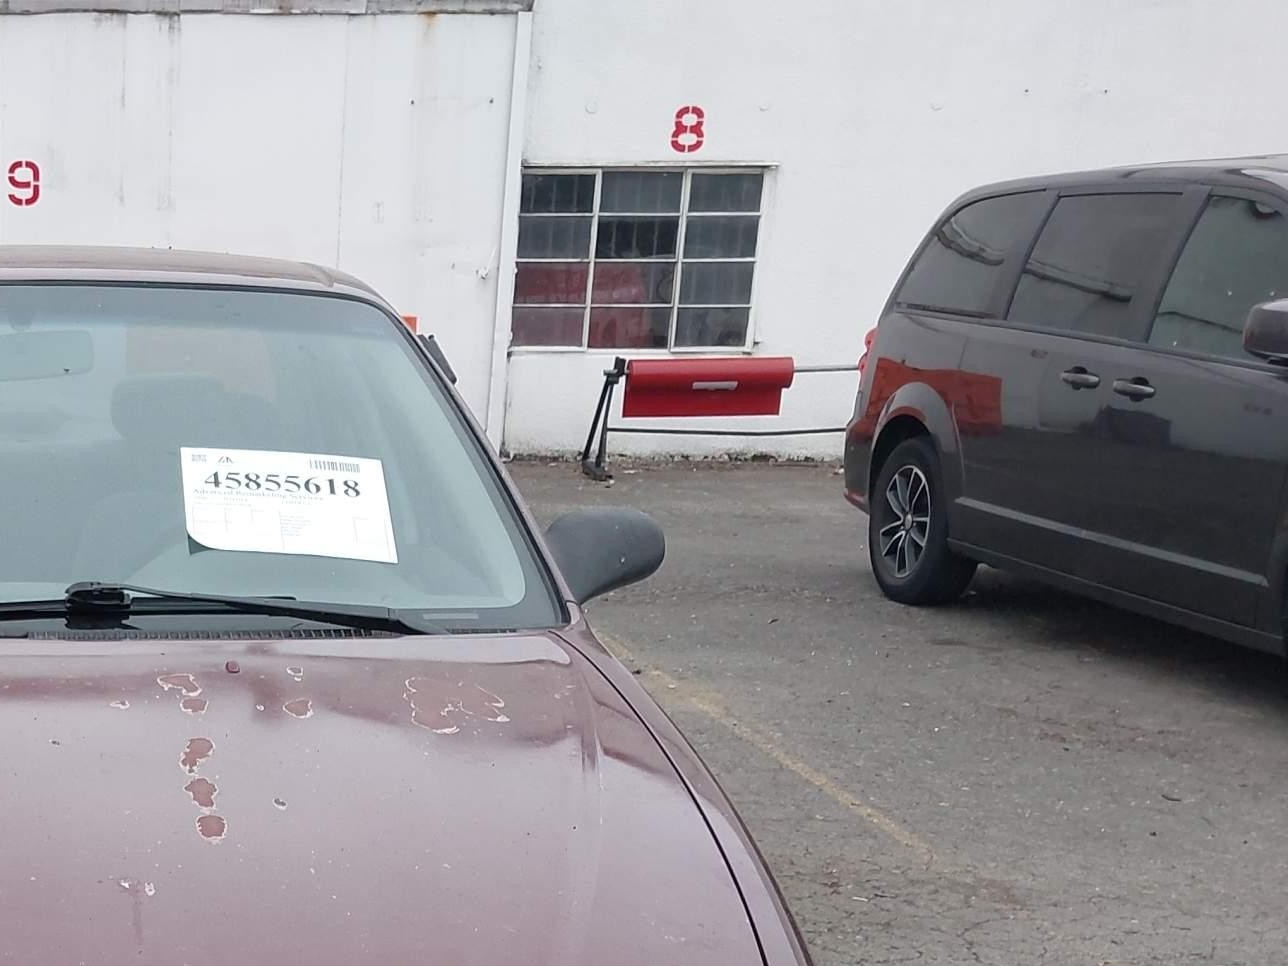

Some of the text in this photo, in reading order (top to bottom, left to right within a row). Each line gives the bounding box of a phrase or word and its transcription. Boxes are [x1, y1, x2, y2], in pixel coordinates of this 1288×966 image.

[669, 105, 705, 154] 8
[7, 159, 42, 207] 9
[203, 470, 362, 499] 45855618
